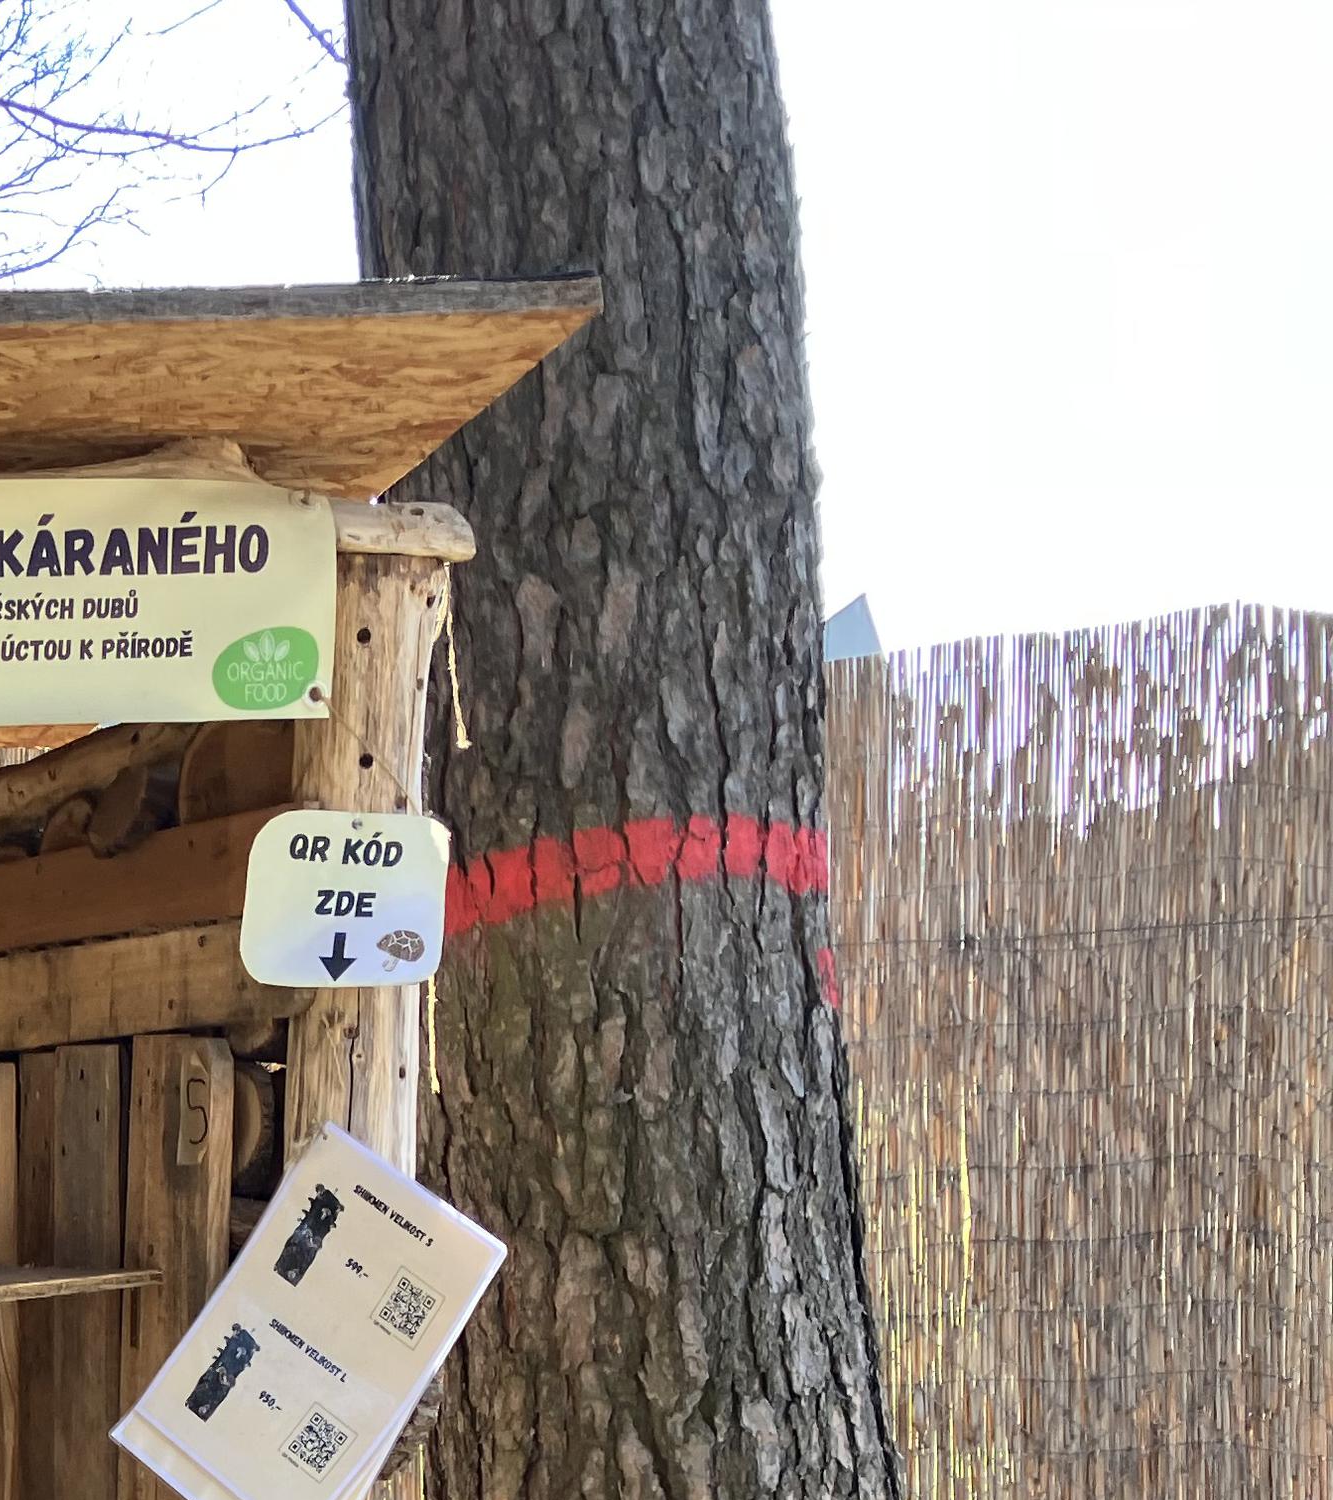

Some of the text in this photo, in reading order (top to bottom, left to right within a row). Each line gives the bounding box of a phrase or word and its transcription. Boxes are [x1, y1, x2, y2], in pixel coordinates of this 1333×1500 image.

[82, 589, 140, 620] DUBŮ
[0, 636, 69, 662] ÚCTOU
[79, 640, 95, 660] K
[101, 634, 194, 660] PŘÍRODĚ
[226, 661, 303, 681] ORGANIC
[244, 683, 286, 702] FOOD
[289, 832, 403, 867] QR KÓD
[315, 890, 376, 918] ZDE
[390, 1211, 426, 1241] VELIKOST
[425, 1238, 434, 1247] S
[305, 1343, 341, 1377] VELIKOST
